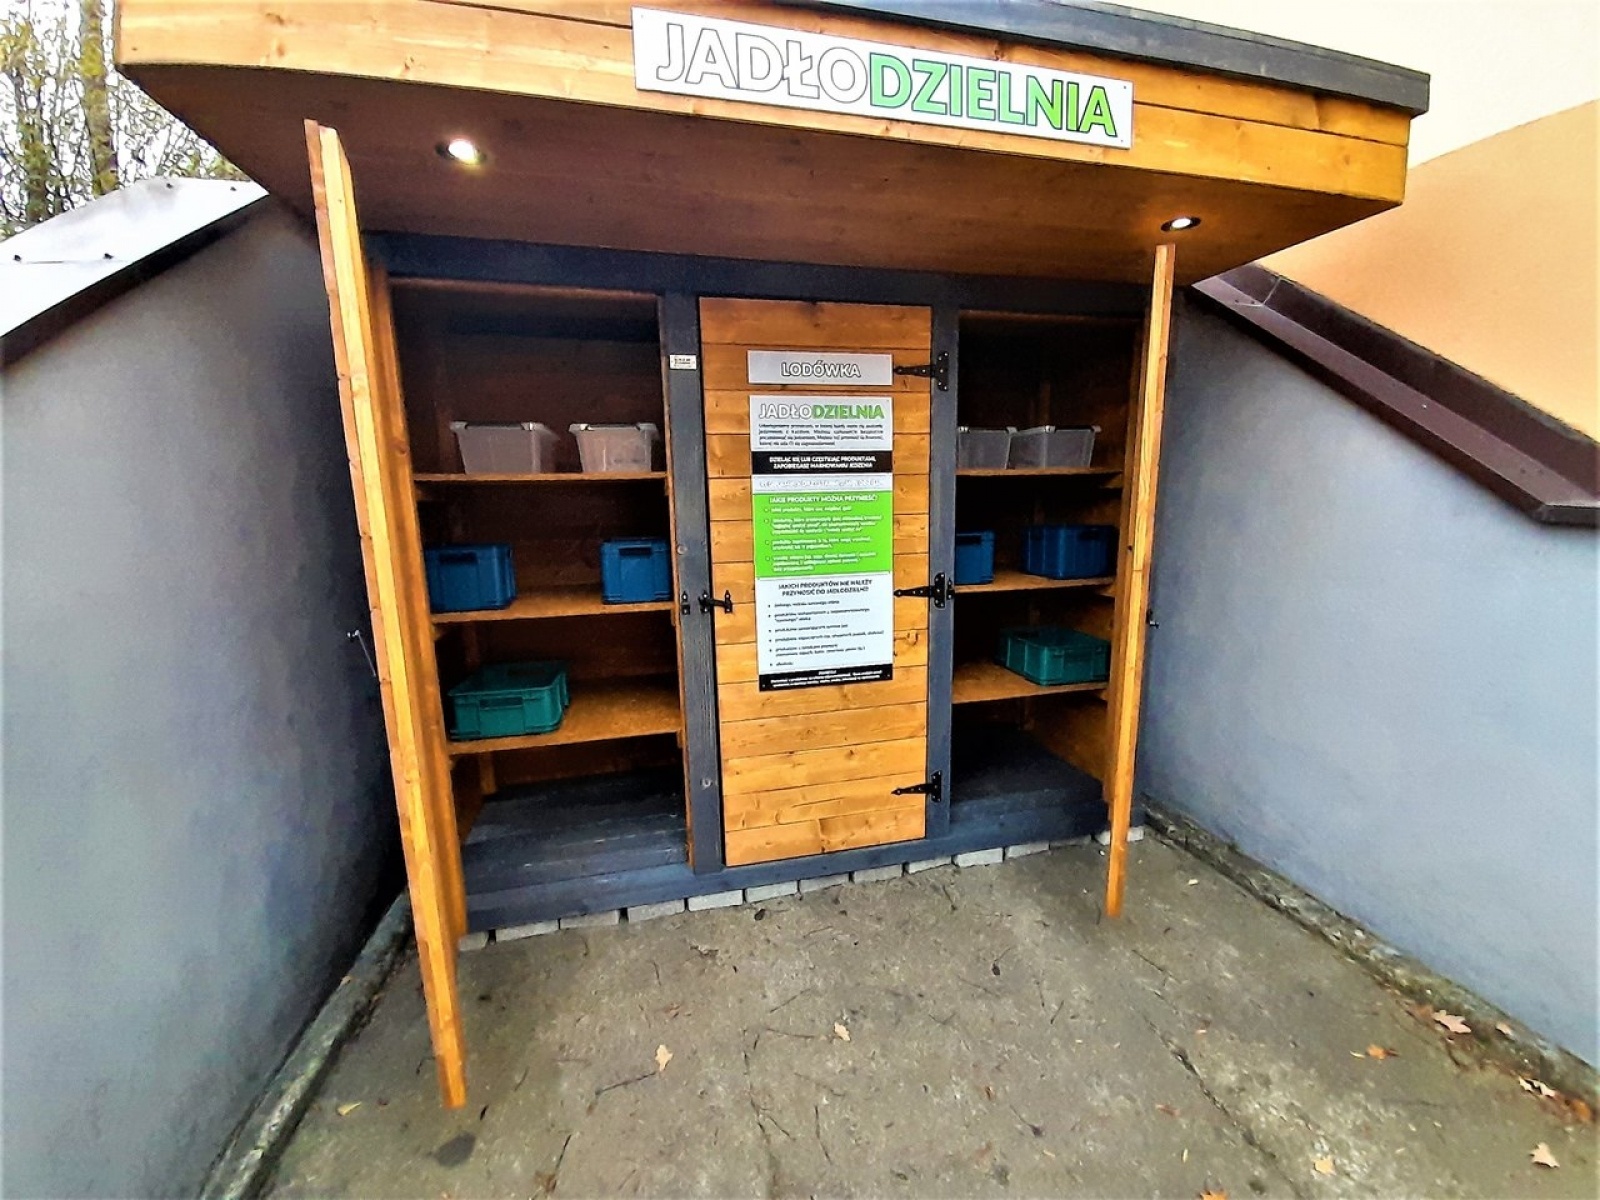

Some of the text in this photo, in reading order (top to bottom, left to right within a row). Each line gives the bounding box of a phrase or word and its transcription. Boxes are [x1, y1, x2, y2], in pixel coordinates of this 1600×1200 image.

[656, 23, 1117, 137] JADŁODZIELNIA
[781, 360, 861, 377] LODÓWKA
[759, 403, 885, 420] JADŁODZIELNIA
